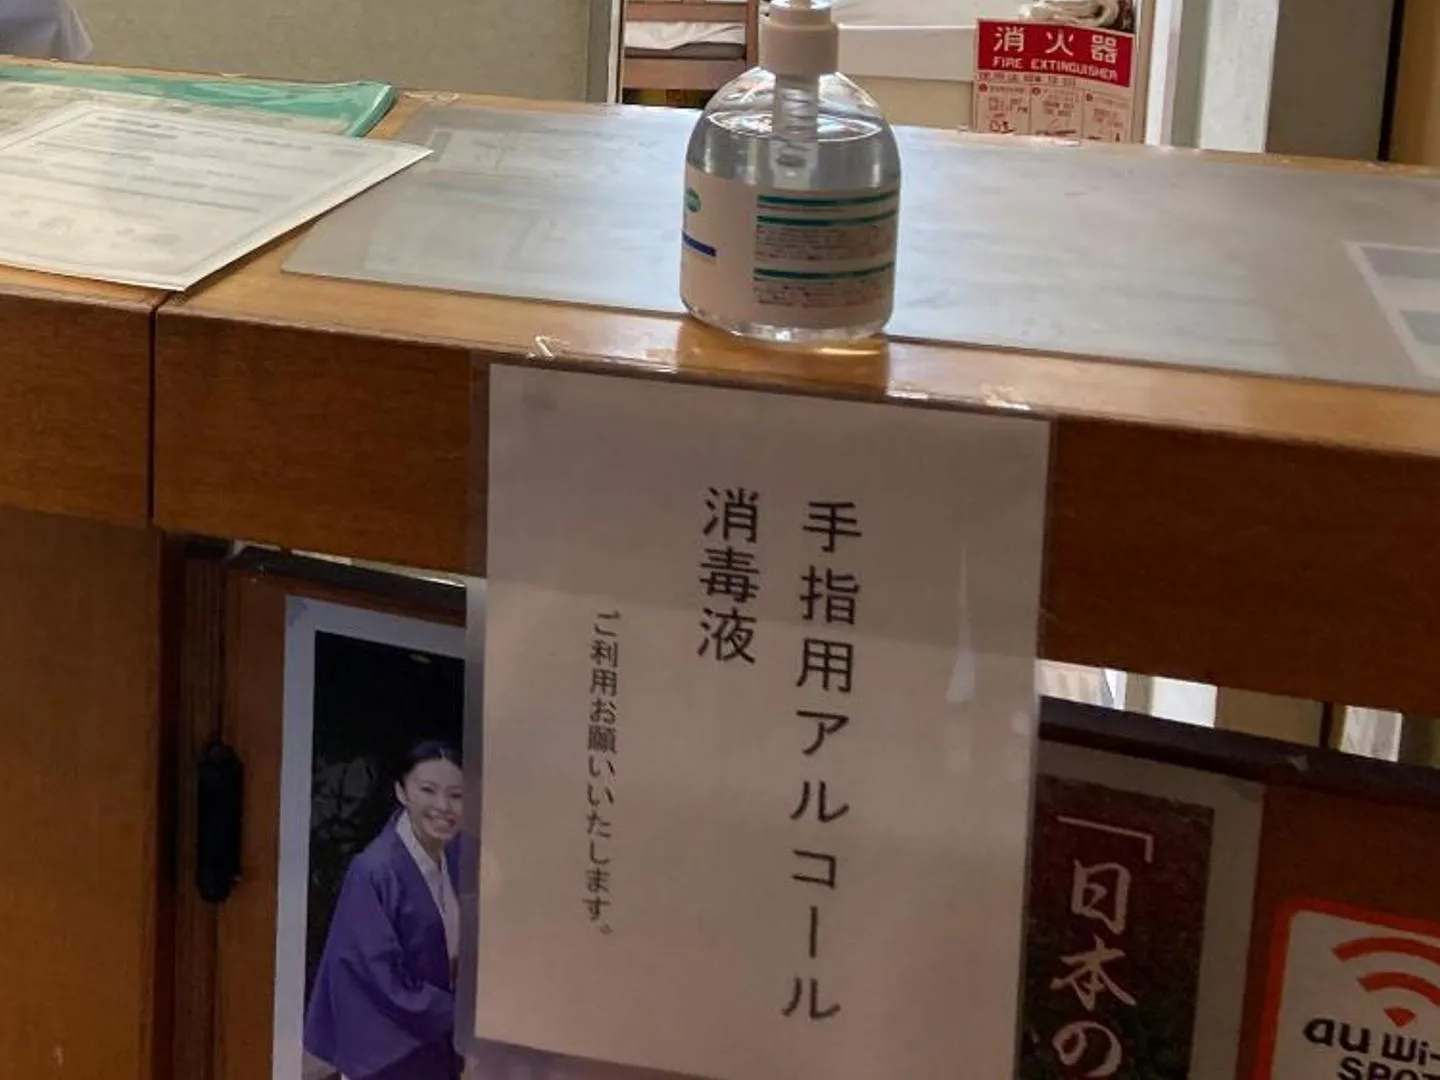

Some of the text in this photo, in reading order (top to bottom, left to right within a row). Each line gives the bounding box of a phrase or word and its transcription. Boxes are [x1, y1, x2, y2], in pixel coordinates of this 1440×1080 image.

[992, 25, 1118, 64] 消火器
[992, 56, 1024, 70] FIRE
[1030, 57, 1118, 82] EXTINGUISHER
[696, 486, 760, 665] 消毒液
[582, 609, 622, 937] ご利用お願いいたします。
[781, 500, 862, 1021] 手指用アルコール
[1303, 1017, 1371, 1054] au
[1336, 1055, 1440, 1080] SP
